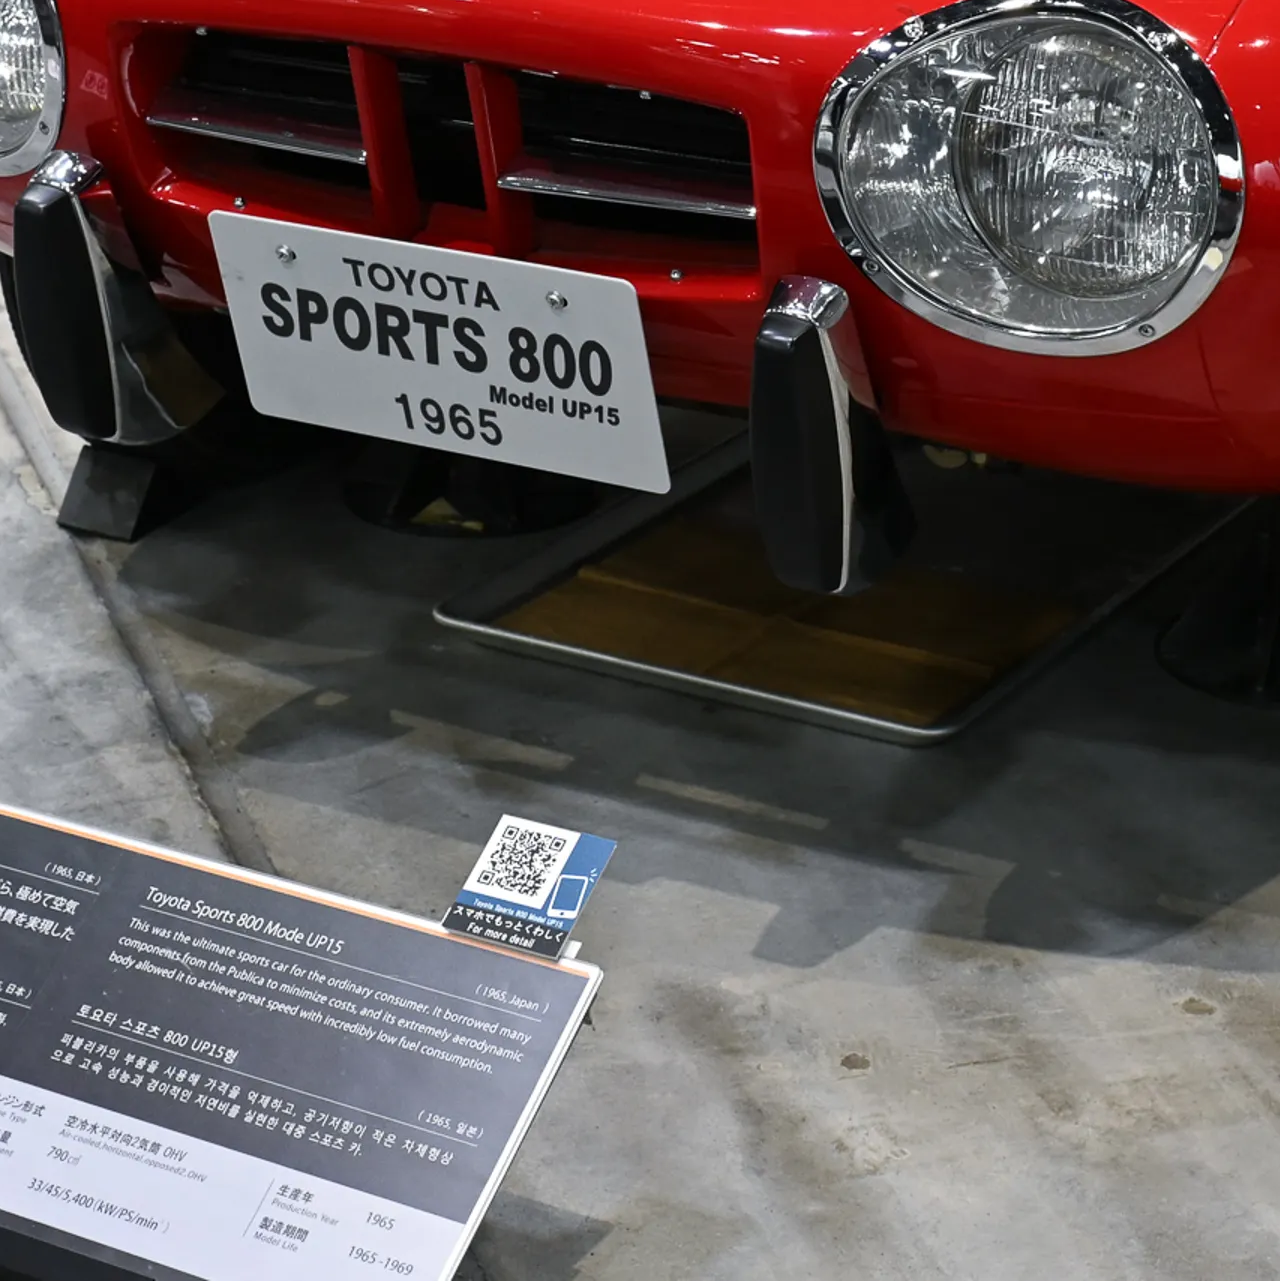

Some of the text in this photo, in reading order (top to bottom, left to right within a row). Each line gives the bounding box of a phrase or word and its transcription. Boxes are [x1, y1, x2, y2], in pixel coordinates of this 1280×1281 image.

[342, 257, 500, 312] TOYOTA
[260, 282, 613, 397] SPORTS 800
[394, 392, 504, 446] 1965
[489, 385, 621, 427] Model UP15
[146, 885, 345, 954] Toyota Sports 800 Mode UP15
[453, 905, 563, 942] スマホでもっとくわしく
[473, 898, 493, 910] Toyota
[528, 912, 546, 923] Model
[547, 917, 564, 928] UP15
[467, 922, 536, 948] For more detail
[129, 917, 532, 1045] This was the ultimate sports car for the ordinary consumer. It borrowed many
[108, 950, 493, 1074] body allowed it to achieve great speed with incredibly low fuel consumption.
[118, 936, 524, 1062] components from the Publica to minimize costs, and its extremely aerodynamic
[76, 1004, 239, 1064] 토요타 스포츠 800 UP15형
[50, 1049, 75, 1065] 으로
[281, 1121, 306, 1139] 대중
[308, 1131, 345, 1150] 스포츠
[8, 1111, 27, 1124] Type
[162, 1146, 188, 1162] OHV
[372, 1128, 396, 1148] 적은
[276, 1184, 314, 1203] 生産年
[270, 1197, 339, 1226] Production Year
[366, 1211, 395, 1230] 1965
[253, 1230, 298, 1252] Model Life
[258, 1216, 309, 1243] 製造期間
[348, 1245, 378, 1264] 1965
